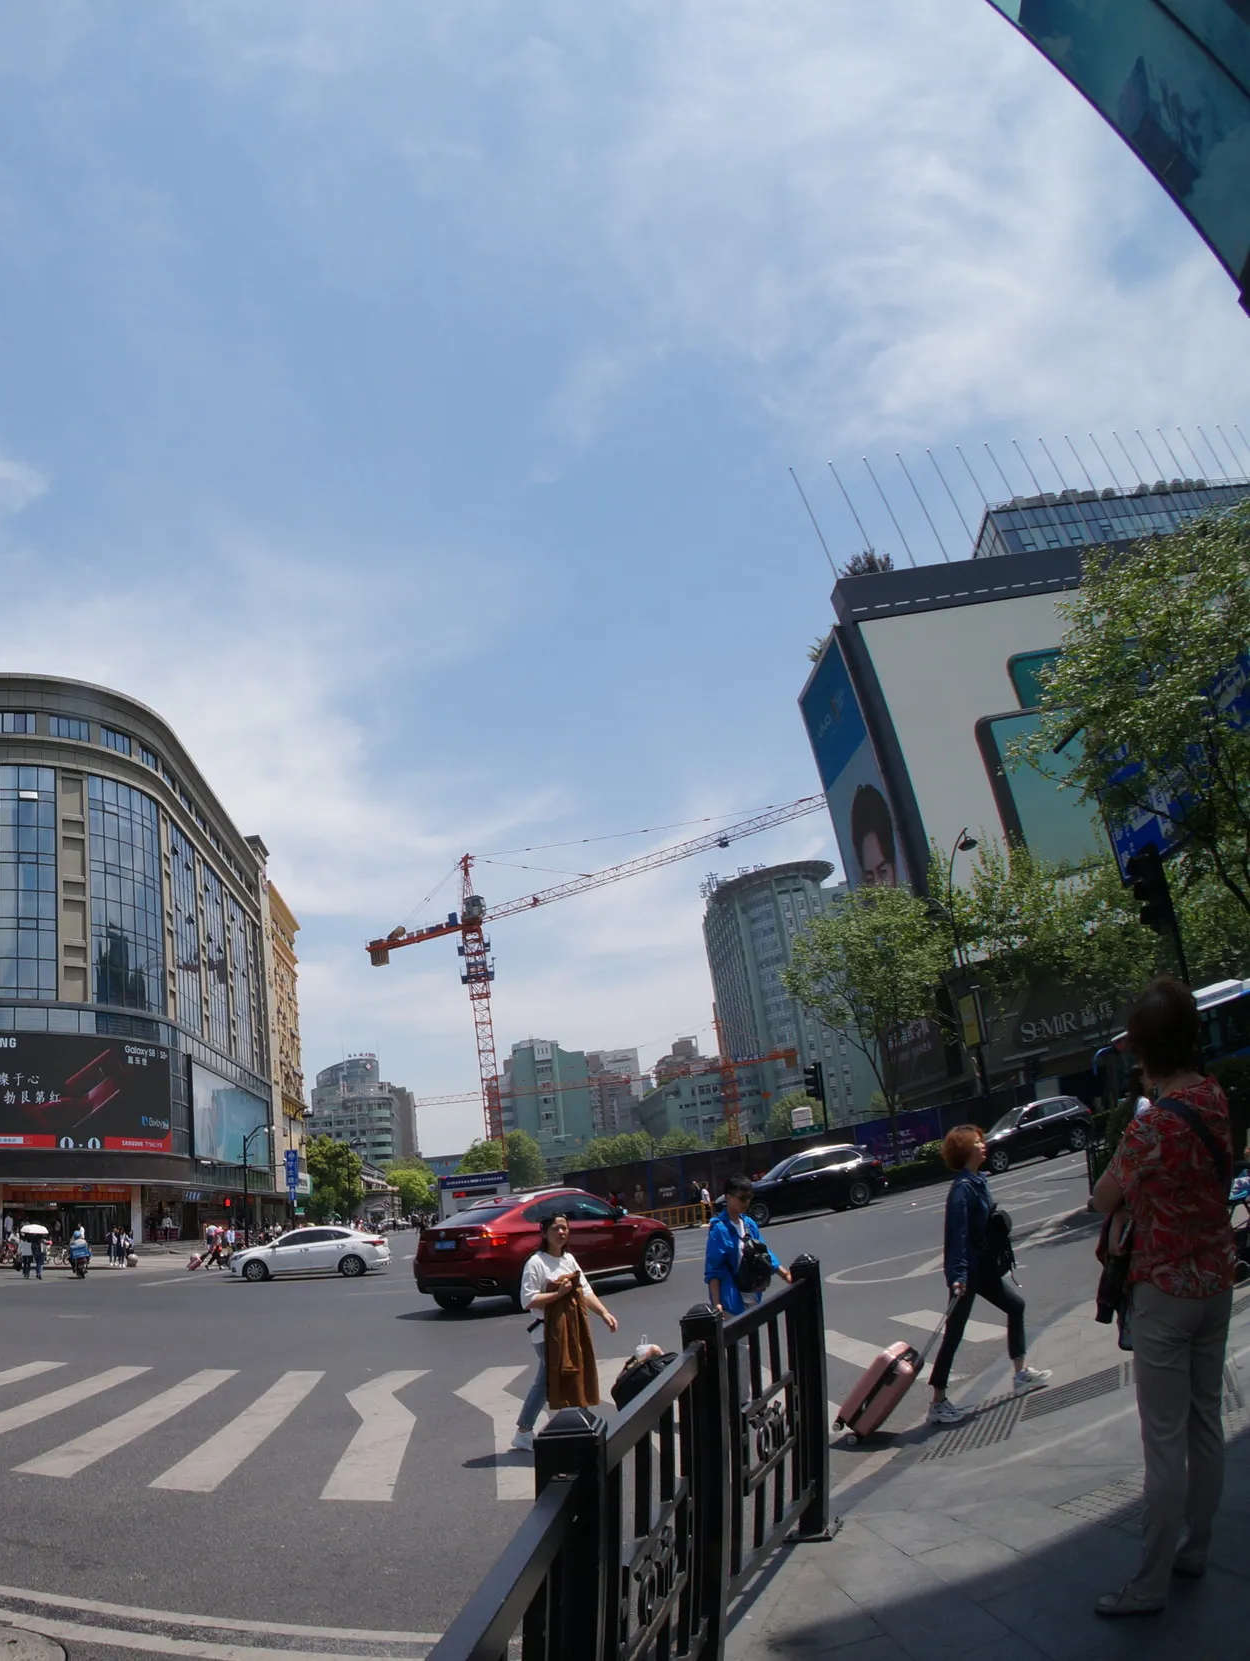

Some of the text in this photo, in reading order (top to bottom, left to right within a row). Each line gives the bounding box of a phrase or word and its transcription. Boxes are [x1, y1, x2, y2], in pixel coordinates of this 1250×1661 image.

[124, 1044, 148, 1057] Galaxy
[3, 1090, 62, 1104] 勃艮第红
